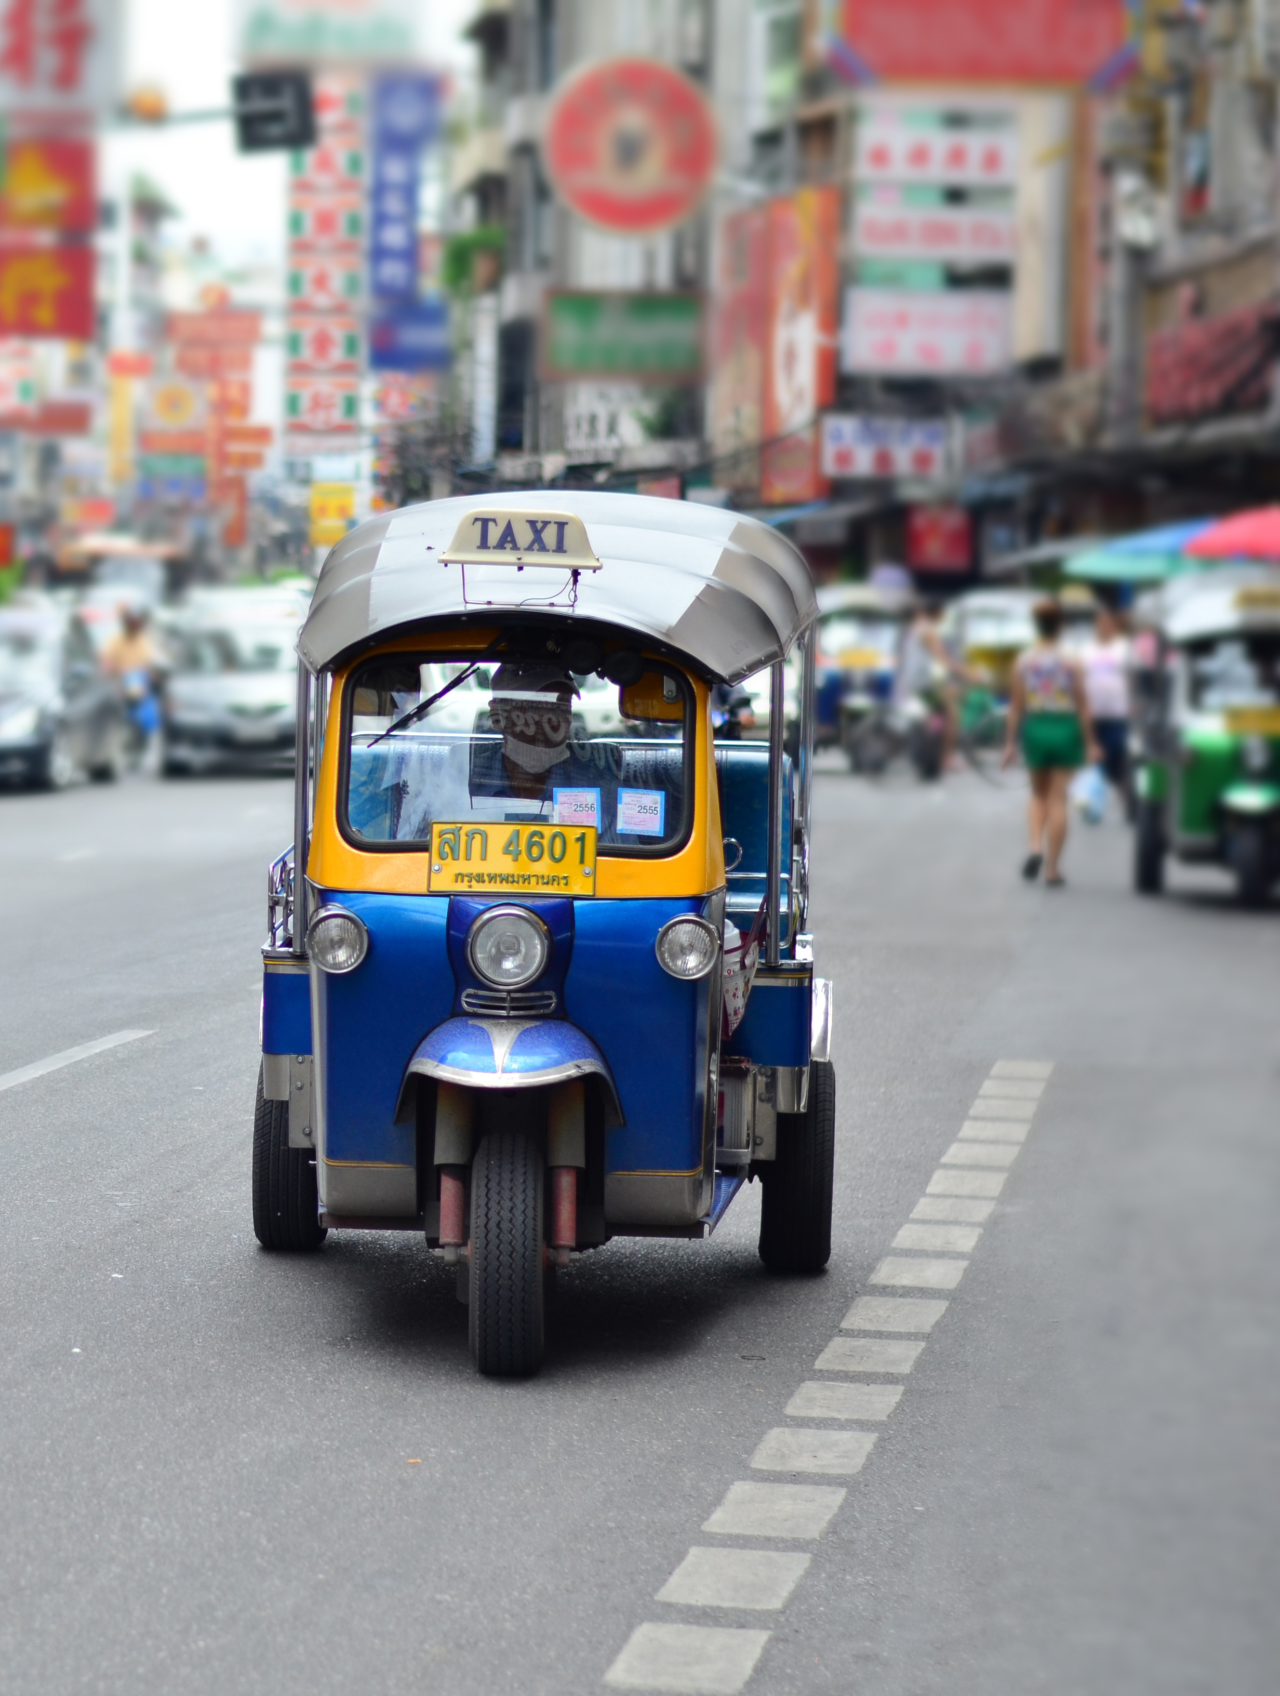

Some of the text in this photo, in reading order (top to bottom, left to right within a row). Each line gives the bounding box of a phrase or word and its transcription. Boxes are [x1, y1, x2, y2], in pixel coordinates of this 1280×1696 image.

[472, 517, 569, 554] TAXI
[573, 803, 596, 813] 2556
[637, 804, 659, 816] 2555
[438, 825, 586, 864] สก 4601
[454, 870, 570, 888] กรุงเทพมหานคร
